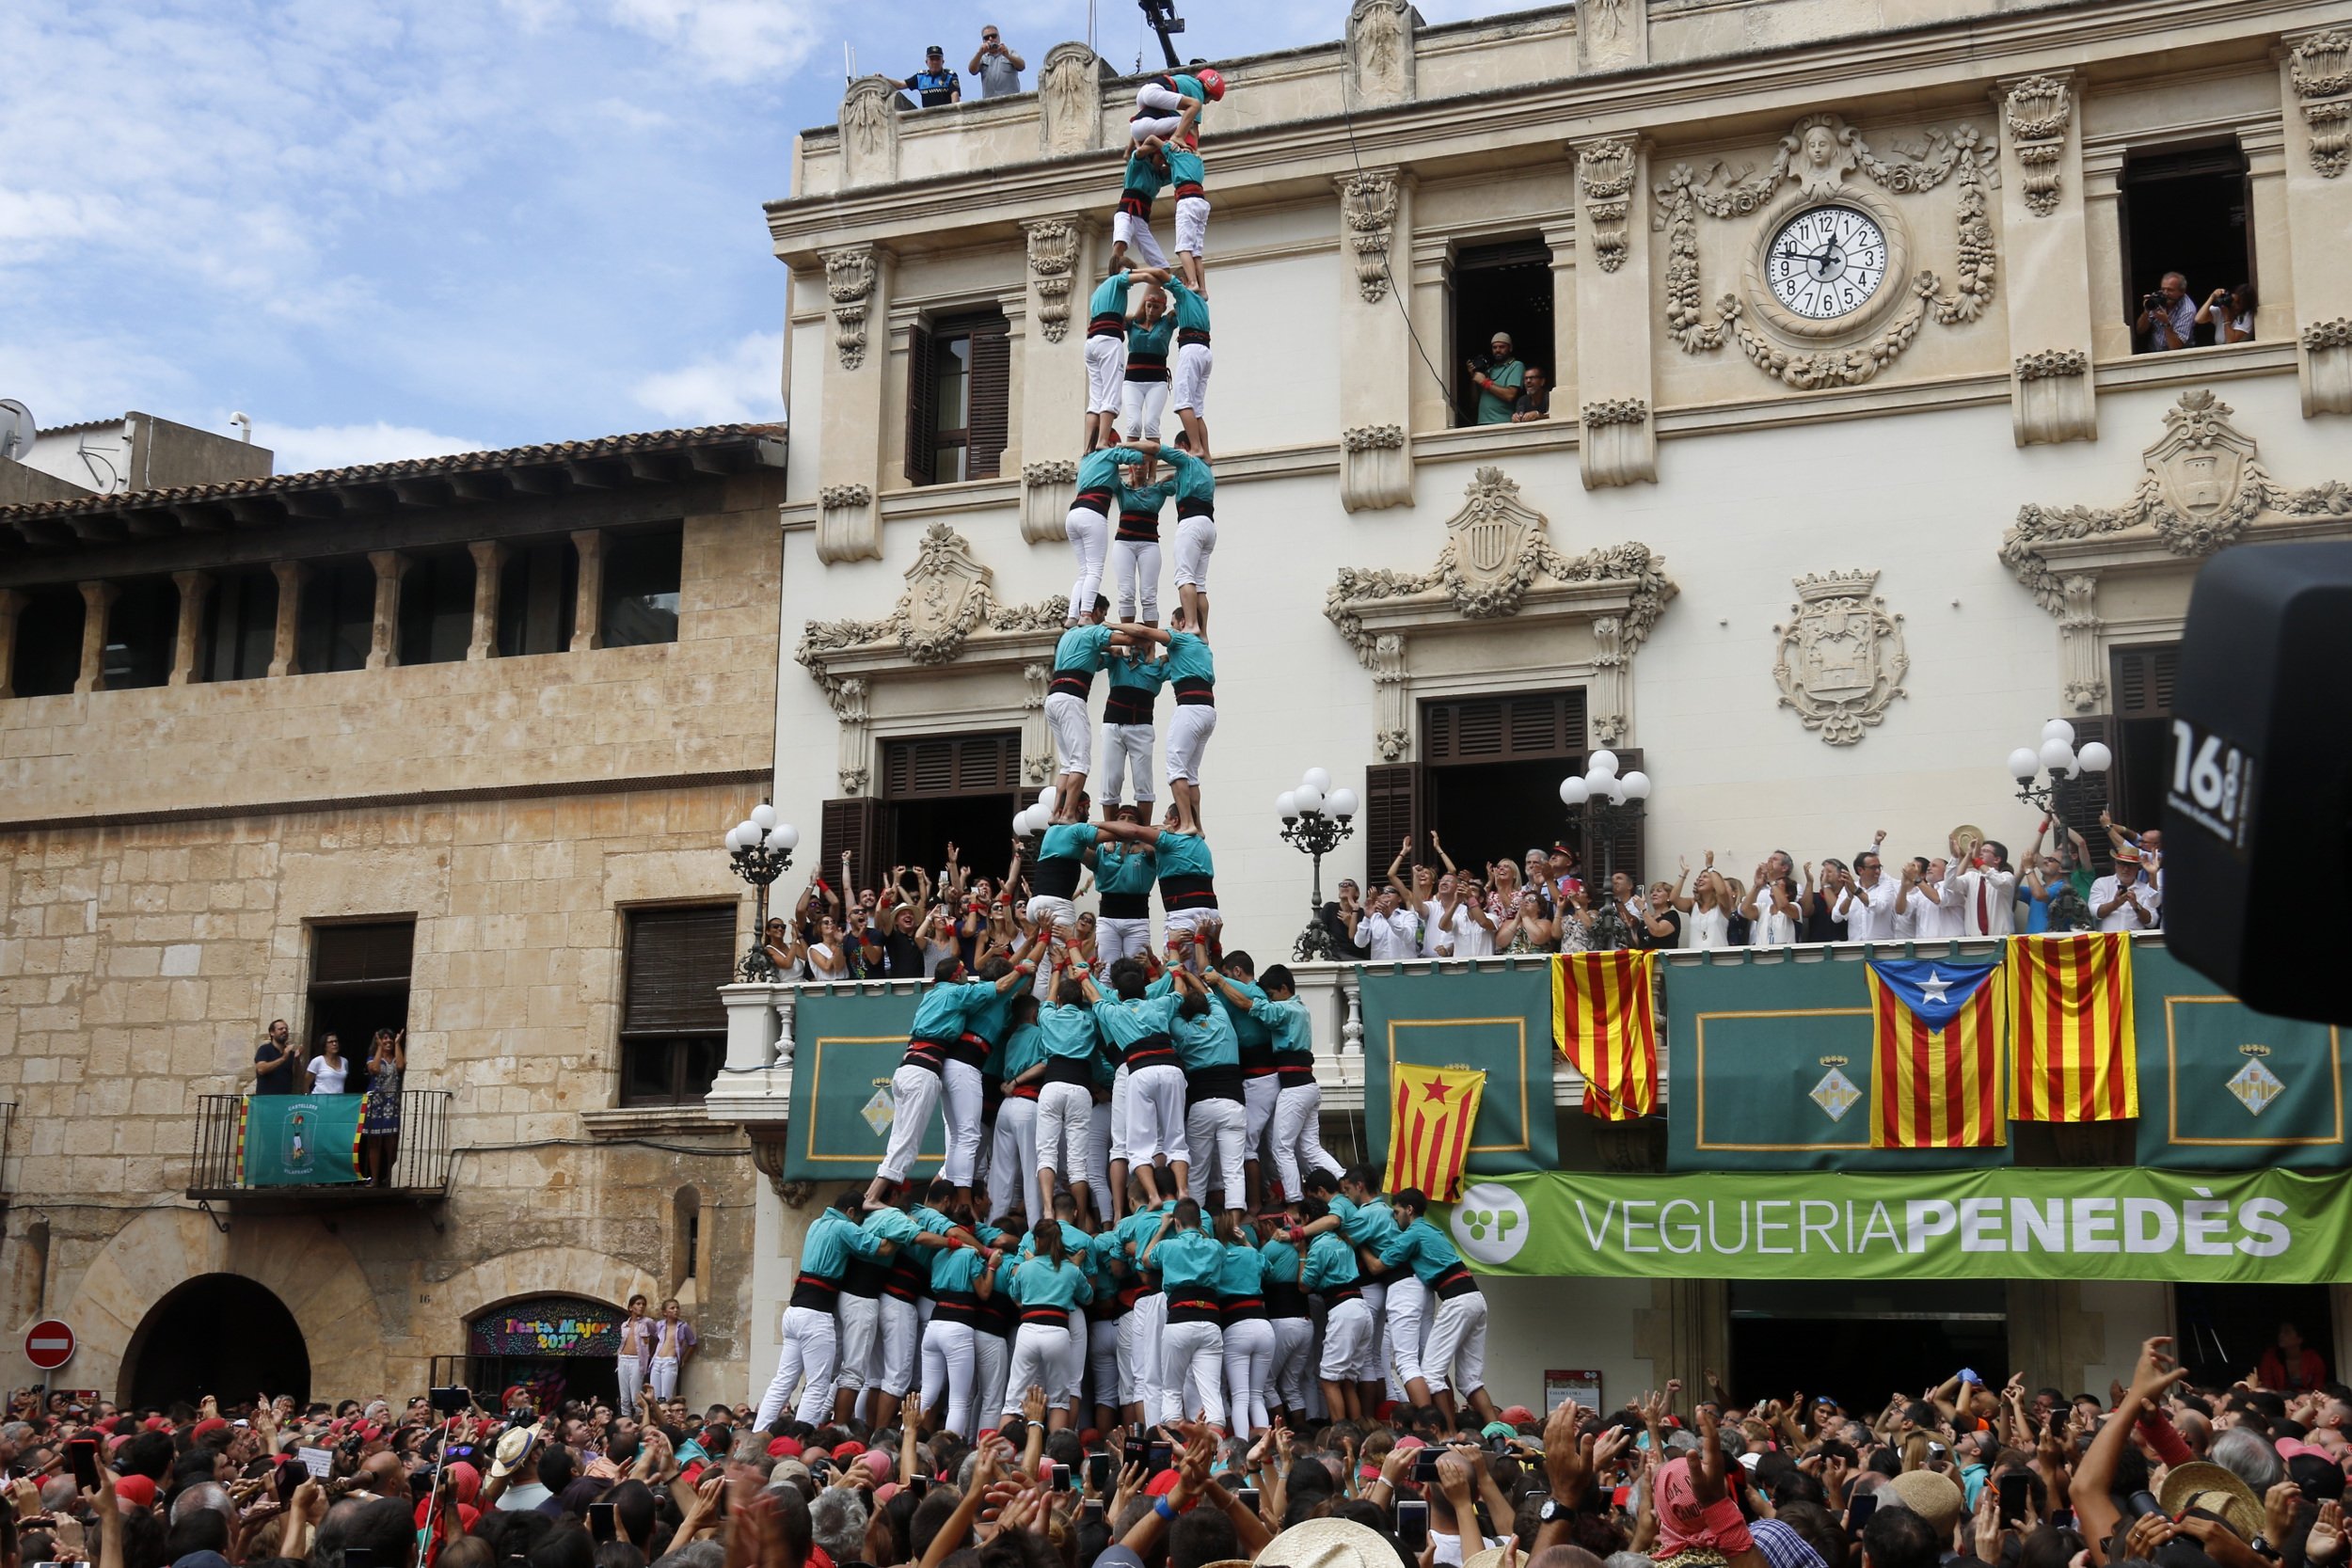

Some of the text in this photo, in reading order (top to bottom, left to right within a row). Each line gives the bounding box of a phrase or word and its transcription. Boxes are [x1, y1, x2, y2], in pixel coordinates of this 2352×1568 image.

[1799, 224, 1809, 241] 11
[1819, 216, 1833, 233] 12
[1844, 219, 1850, 235] 1
[1858, 230, 1868, 247] 2
[1784, 240, 1798, 256] 10
[1865, 250, 1874, 267] 3
[1780, 261, 1789, 277] 9
[1787, 279, 1796, 295] 8
[1858, 271, 1867, 287] 4
[1804, 293, 1814, 309] 7
[1823, 294, 1833, 311] 6
[1844, 288, 1853, 305] 5
[2172, 719, 2222, 810] 16
[420, 1294, 431, 1304] 16
[505, 1318, 612, 1338] Festa Major
[536, 1334, 579, 1349] 2017
